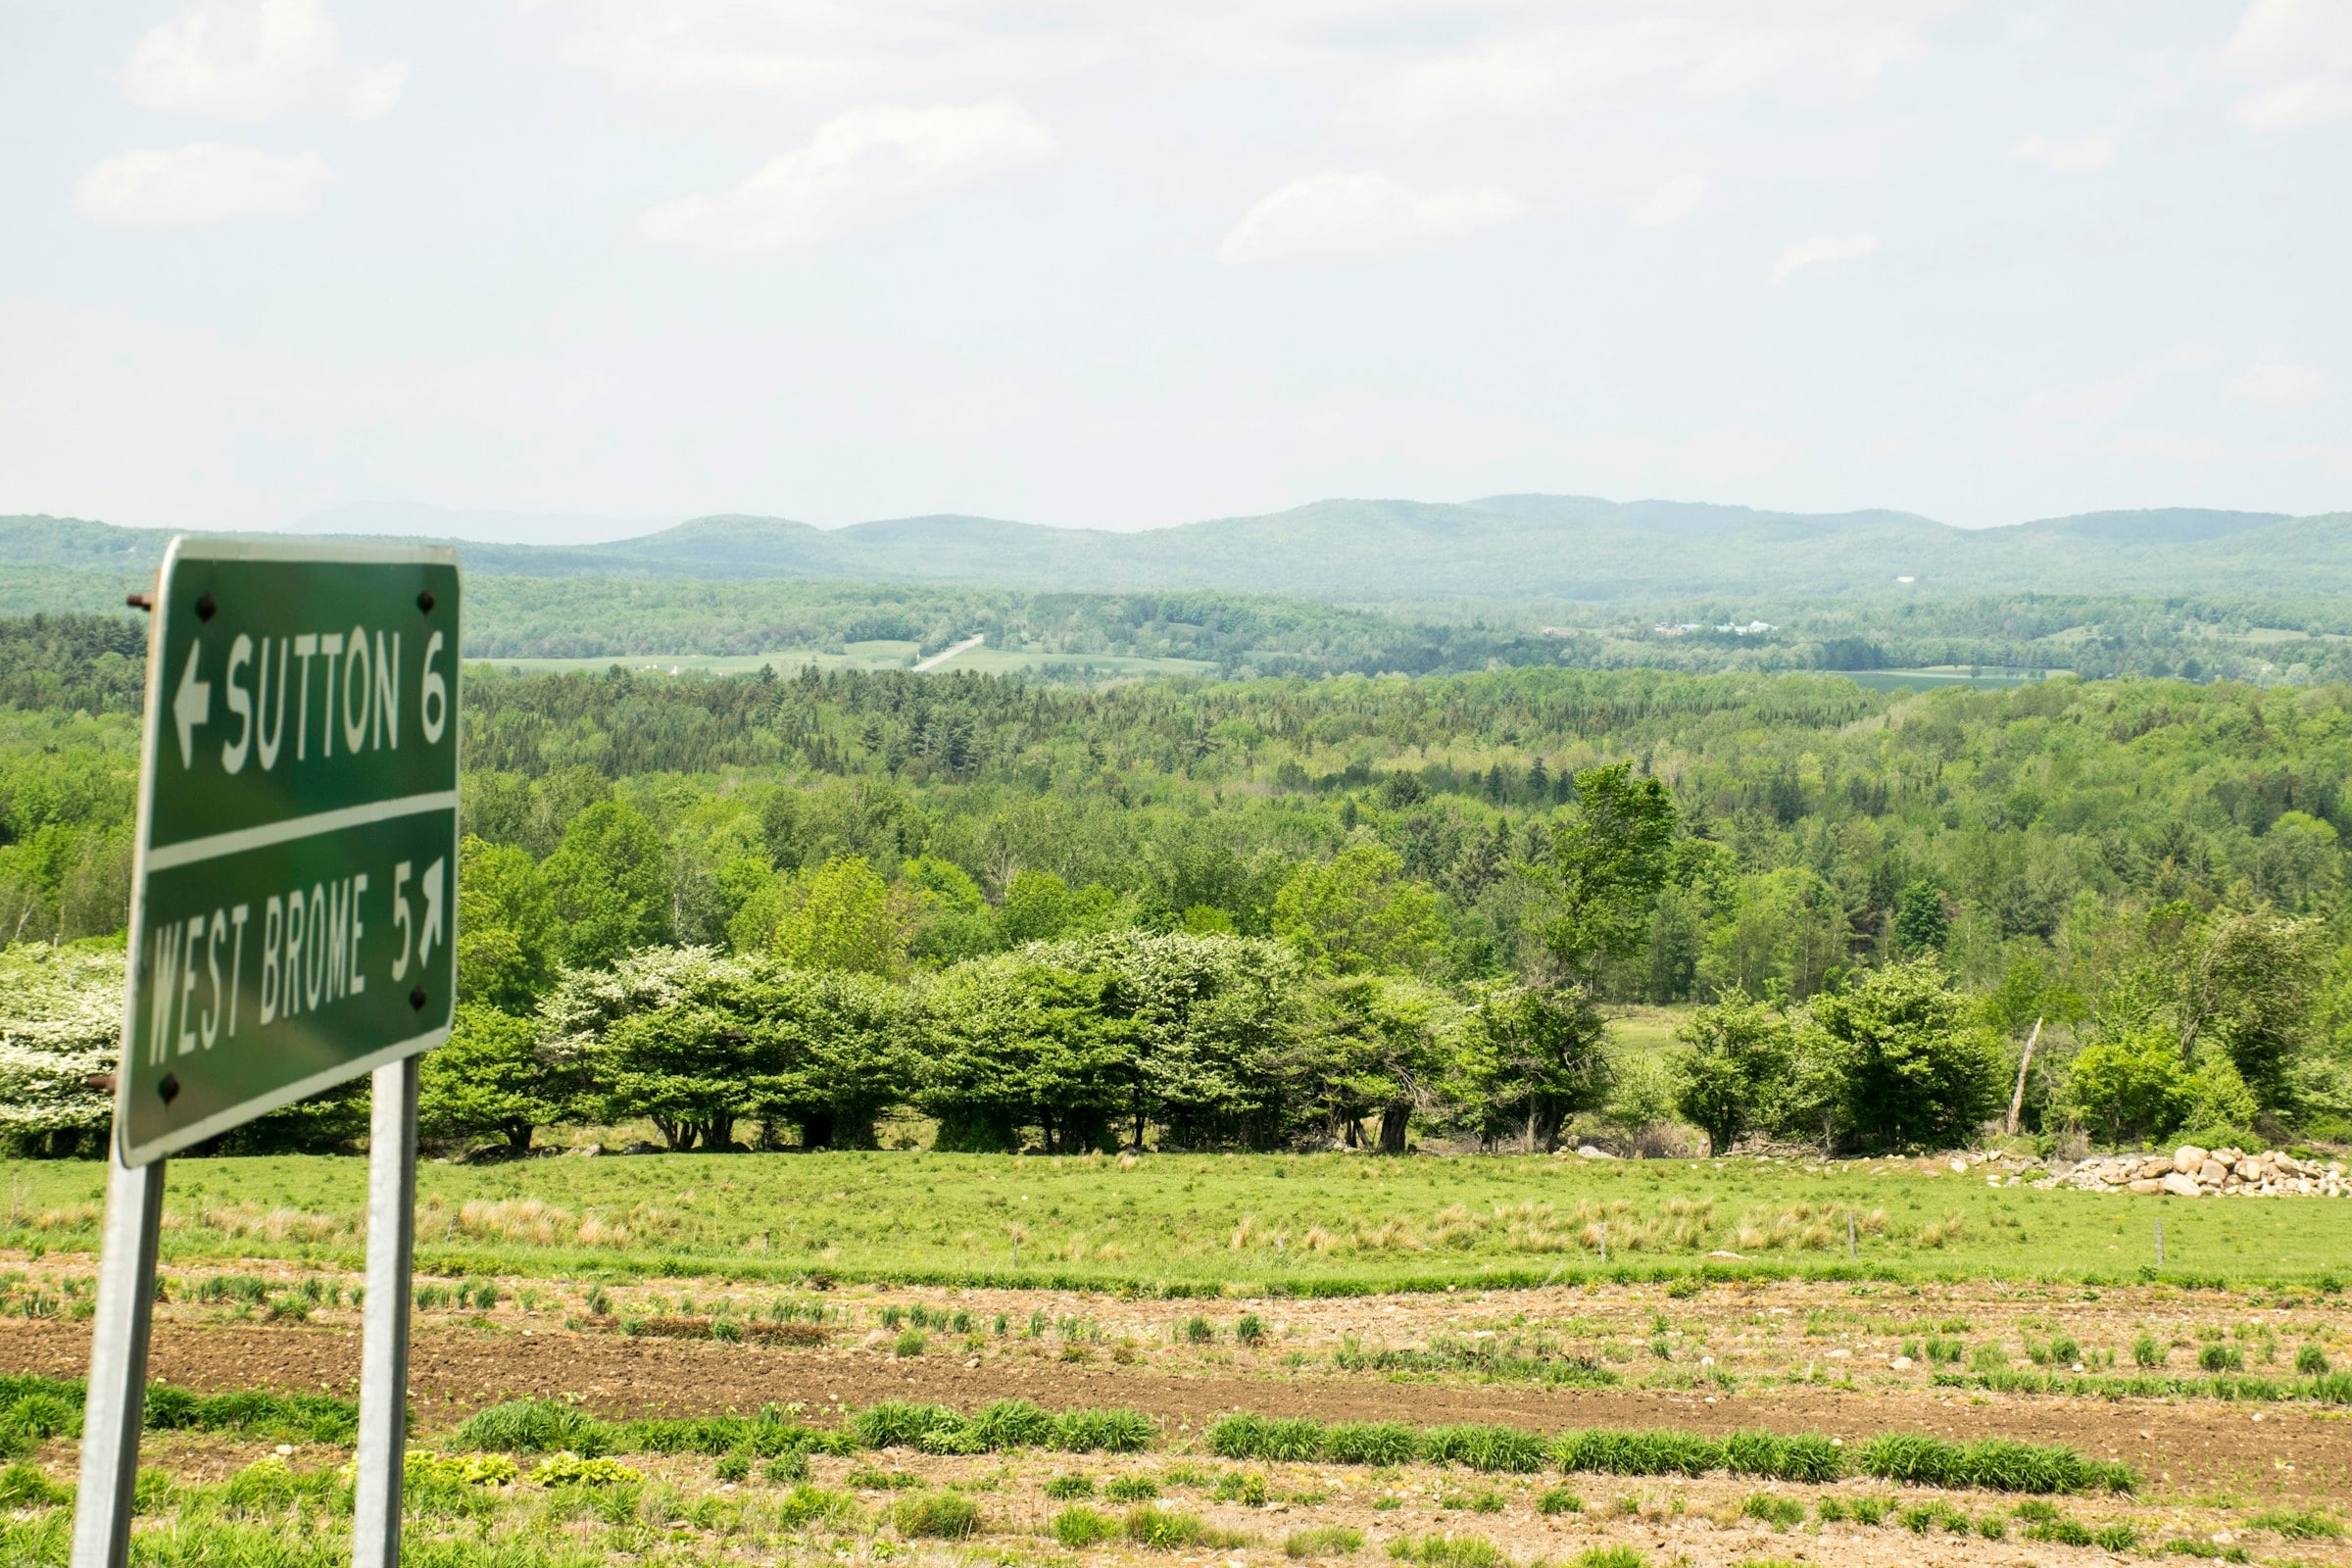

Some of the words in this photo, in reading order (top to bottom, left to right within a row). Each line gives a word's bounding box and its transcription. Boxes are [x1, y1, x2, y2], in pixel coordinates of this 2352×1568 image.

[221, 625, 400, 774] SUTTON
[421, 630, 446, 744] 6
[149, 904, 249, 1066] WEST
[260, 873, 368, 1025] BROME
[392, 860, 412, 982] 5
